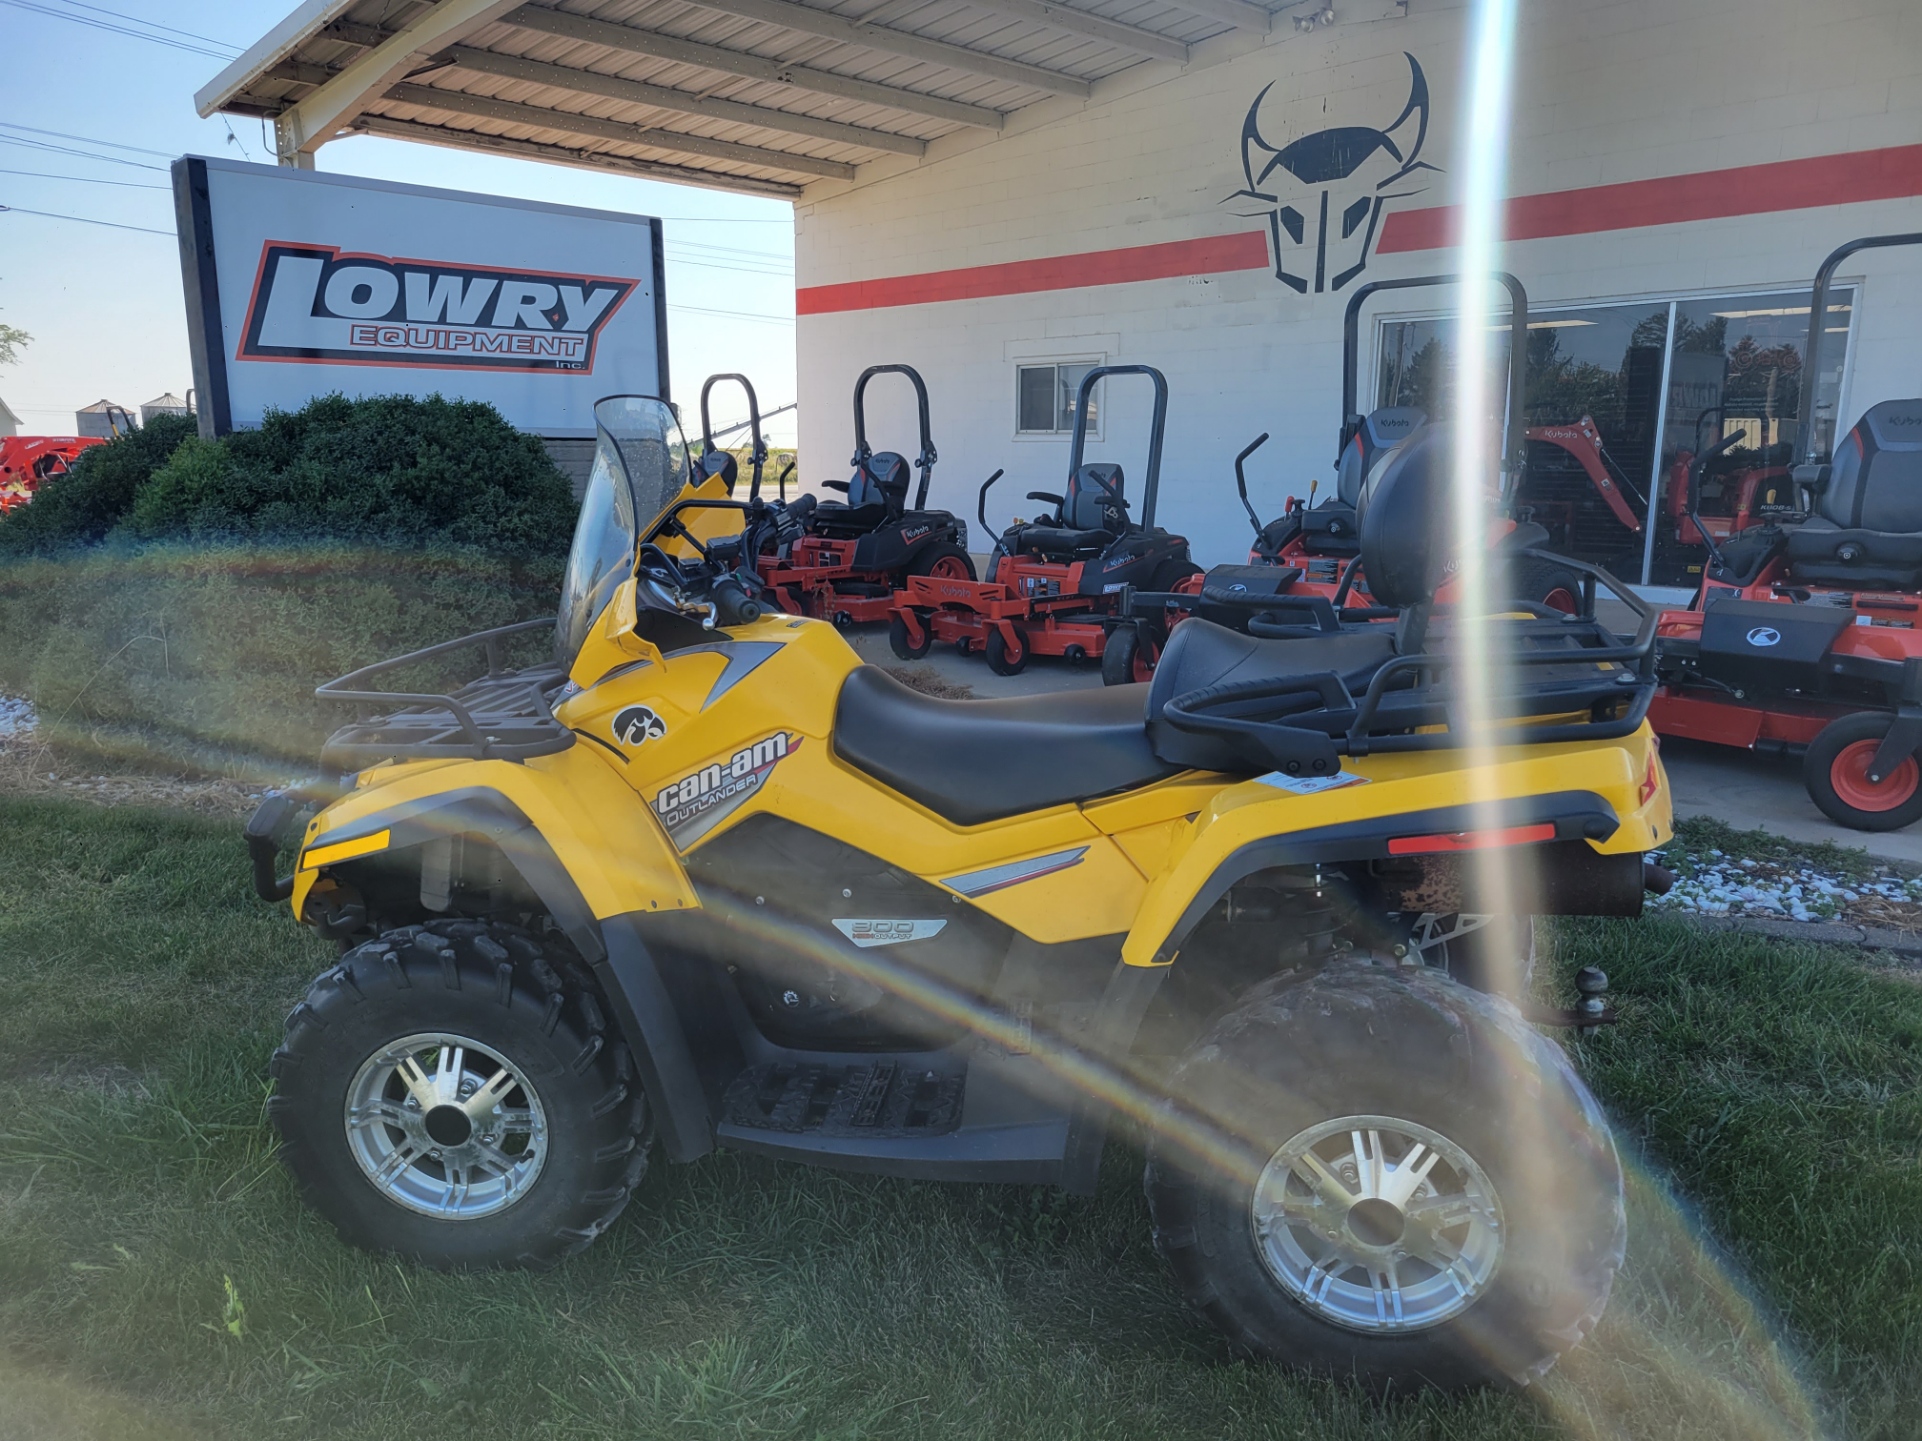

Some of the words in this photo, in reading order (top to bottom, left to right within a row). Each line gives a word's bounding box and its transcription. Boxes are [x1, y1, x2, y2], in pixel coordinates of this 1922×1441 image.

[257, 255, 619, 359] LOWRY
[350, 323, 584, 357] EQUIPMENT
[555, 360, 586, 371] Inc.
[1380, 418, 1409, 427] Kubota
[1544, 430, 1578, 439] Kubota
[906, 525, 930, 538] Kubota
[1110, 554, 1136, 567] Kubota
[940, 584, 972, 598] Kubota
[657, 731, 789, 814] can-am
[666, 773, 758, 827] OUTLANDER
[851, 920, 914, 933] 800
